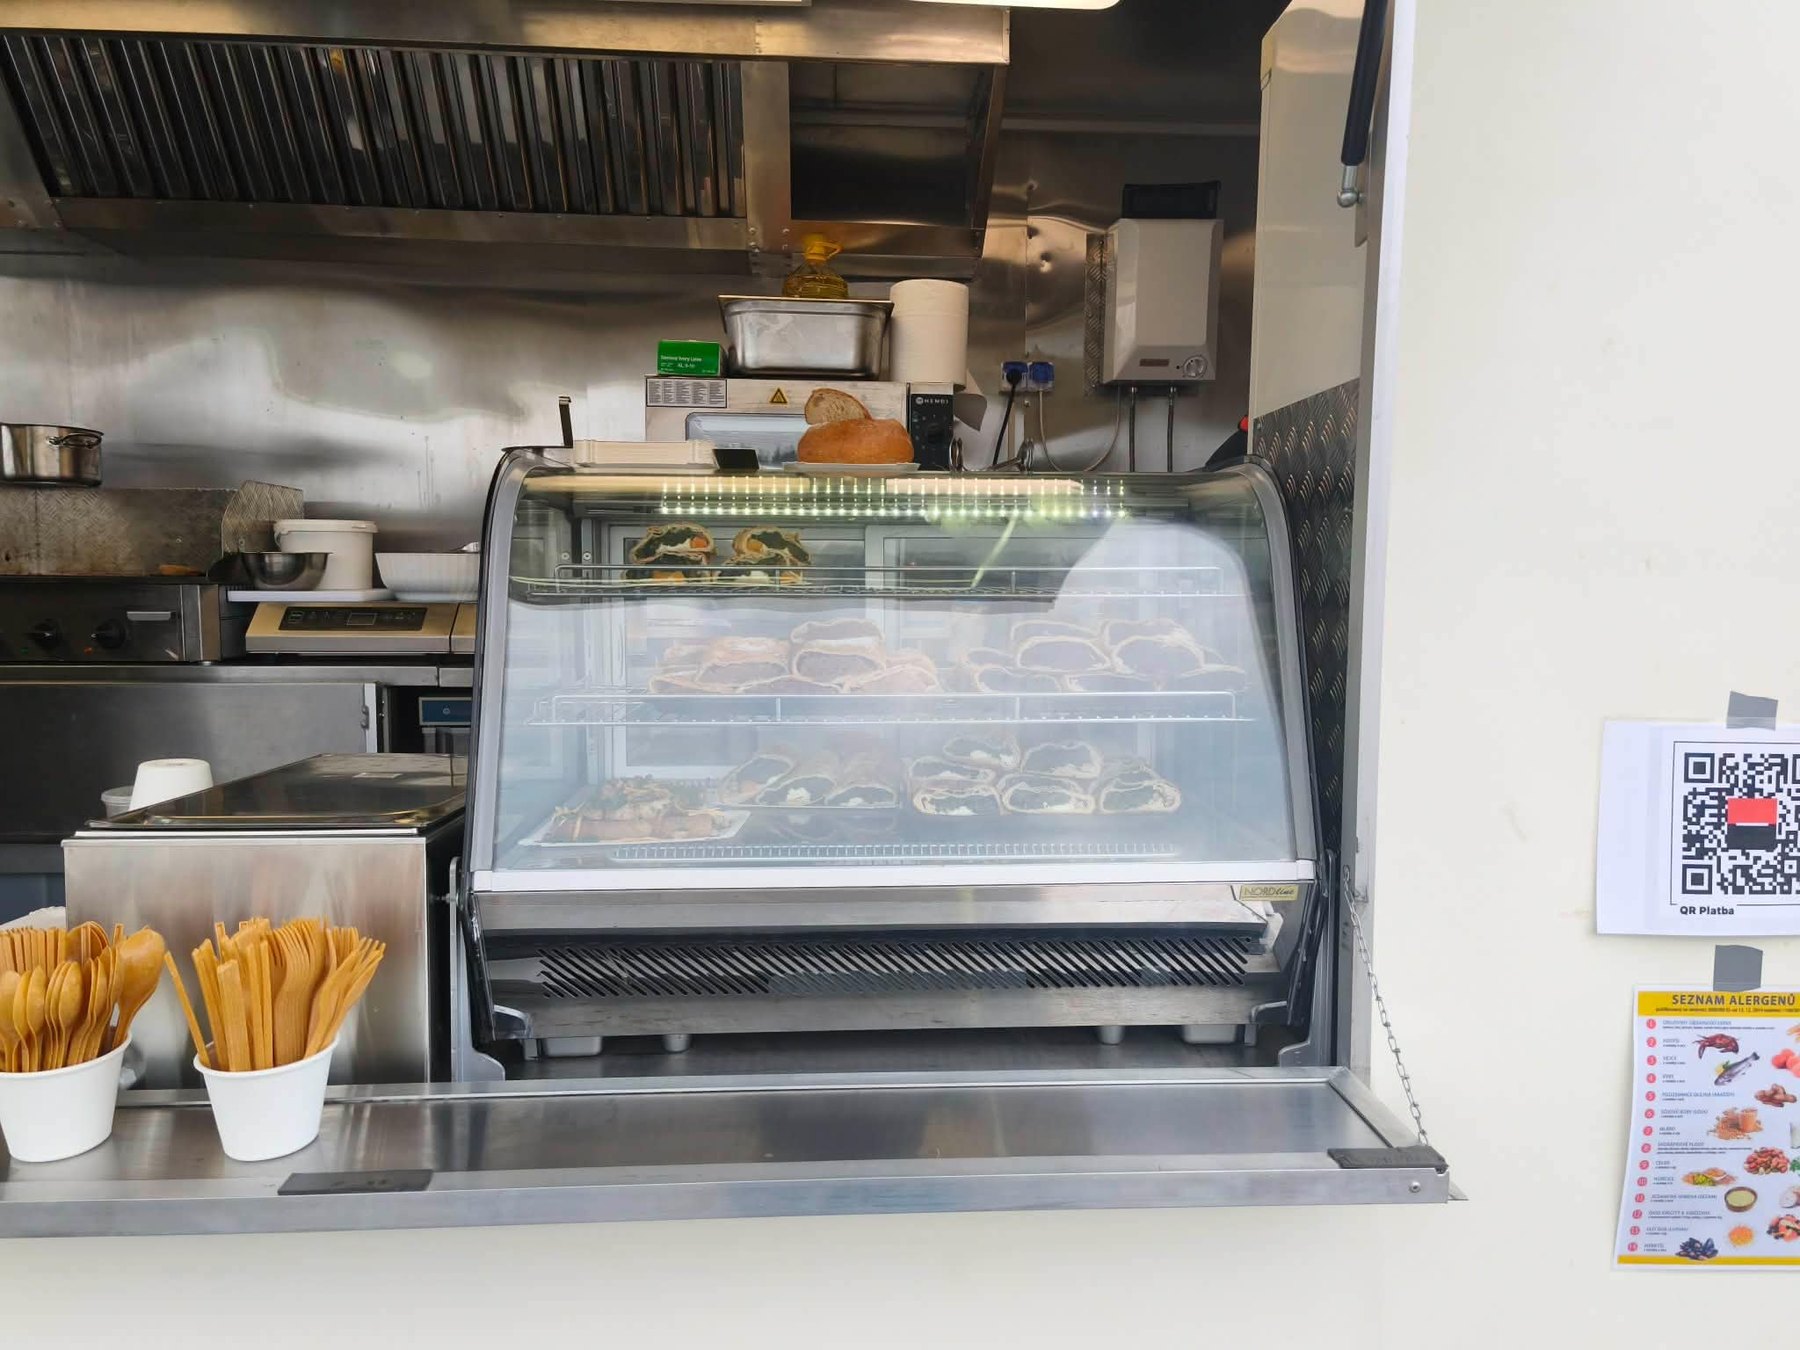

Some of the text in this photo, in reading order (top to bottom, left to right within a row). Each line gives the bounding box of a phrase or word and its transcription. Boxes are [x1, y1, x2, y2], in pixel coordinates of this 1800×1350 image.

[1680, 906, 1735, 915] QR Platba
[1672, 993, 1796, 1006] SEZNAM ALERGENŮ
